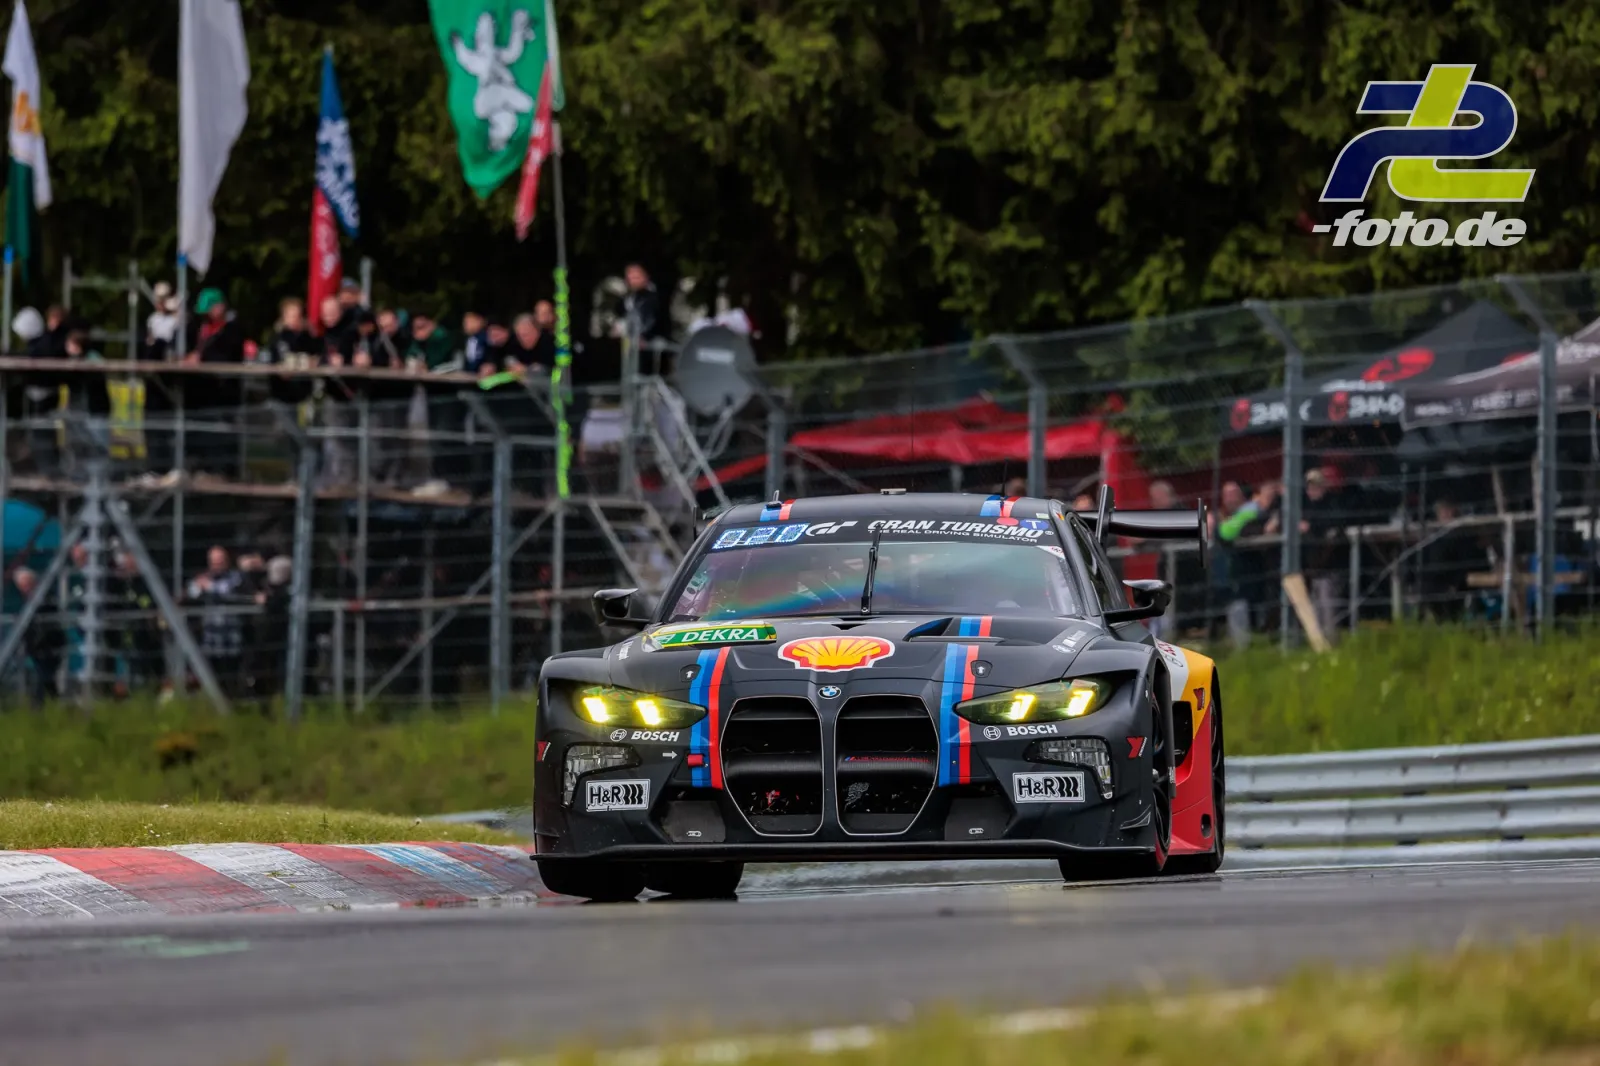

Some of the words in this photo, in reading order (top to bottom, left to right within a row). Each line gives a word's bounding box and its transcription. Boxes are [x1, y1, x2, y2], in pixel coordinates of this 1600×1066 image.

[867, 519, 940, 530] GRAN
[941, 520, 1044, 538] TURISMO
[973, 532, 1038, 543] SIMULATOR
[681, 628, 759, 643] DEKRA
[631, 731, 680, 742] BOSCH
[1007, 724, 1059, 737] BOSCH
[1017, 777, 1057, 797] H&R
[589, 786, 622, 805] H&R
